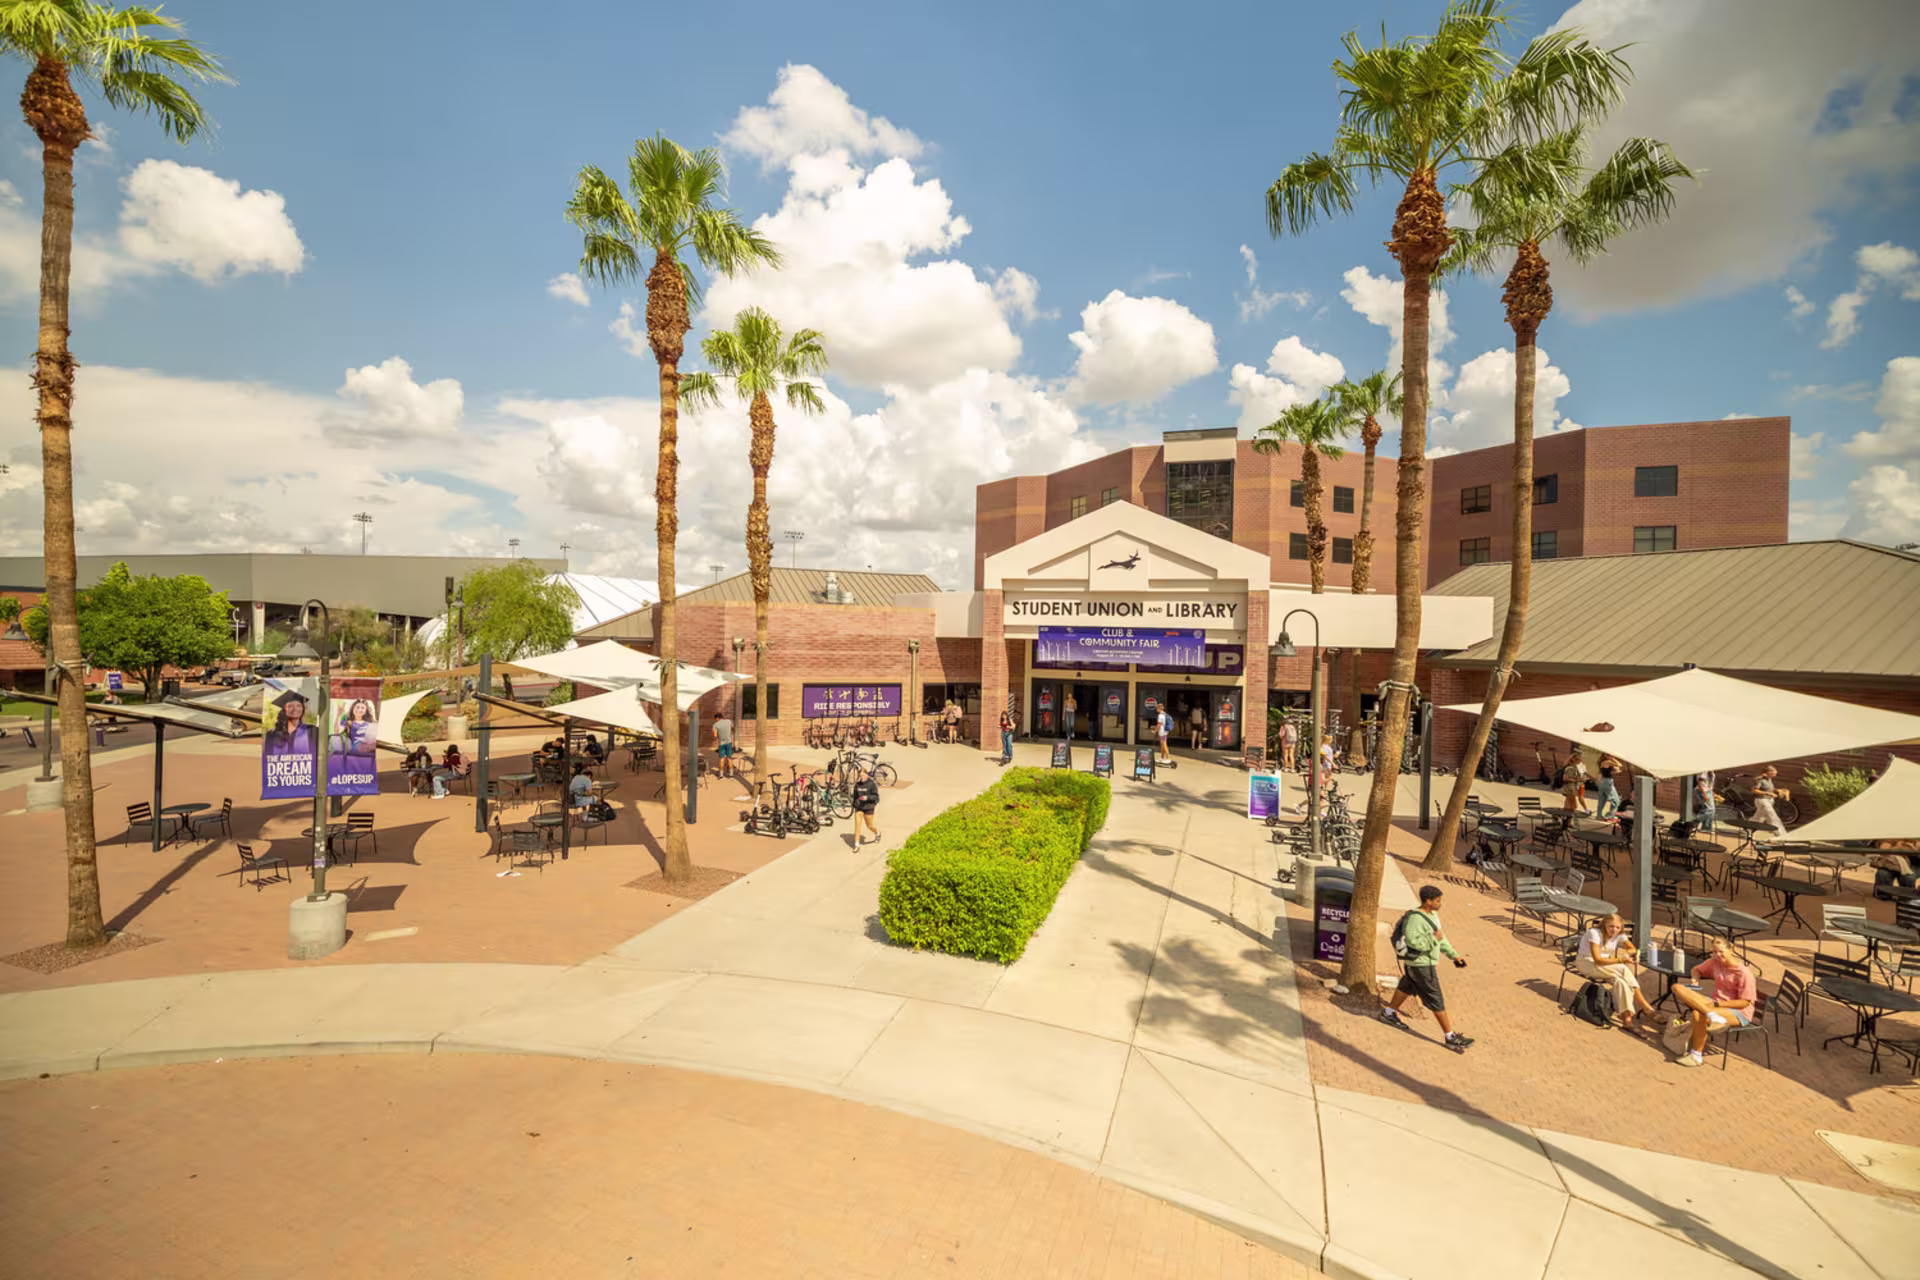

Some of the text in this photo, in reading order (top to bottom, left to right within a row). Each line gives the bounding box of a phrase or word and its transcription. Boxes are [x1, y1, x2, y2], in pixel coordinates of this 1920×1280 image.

[1012, 601, 1082, 616] STUDENT
[1087, 602, 1144, 617] UNION
[1166, 602, 1238, 618] LIBRARY
[1101, 628, 1134, 637] CLUB &
[1079, 637, 1160, 649] COMMUNITY FAIR
[266, 753, 313, 762] THE AMERICAN
[267, 761, 312, 776] DREAM
[267, 774, 312, 787] IS YOURS
[331, 774, 374, 785] #LOPESUP
